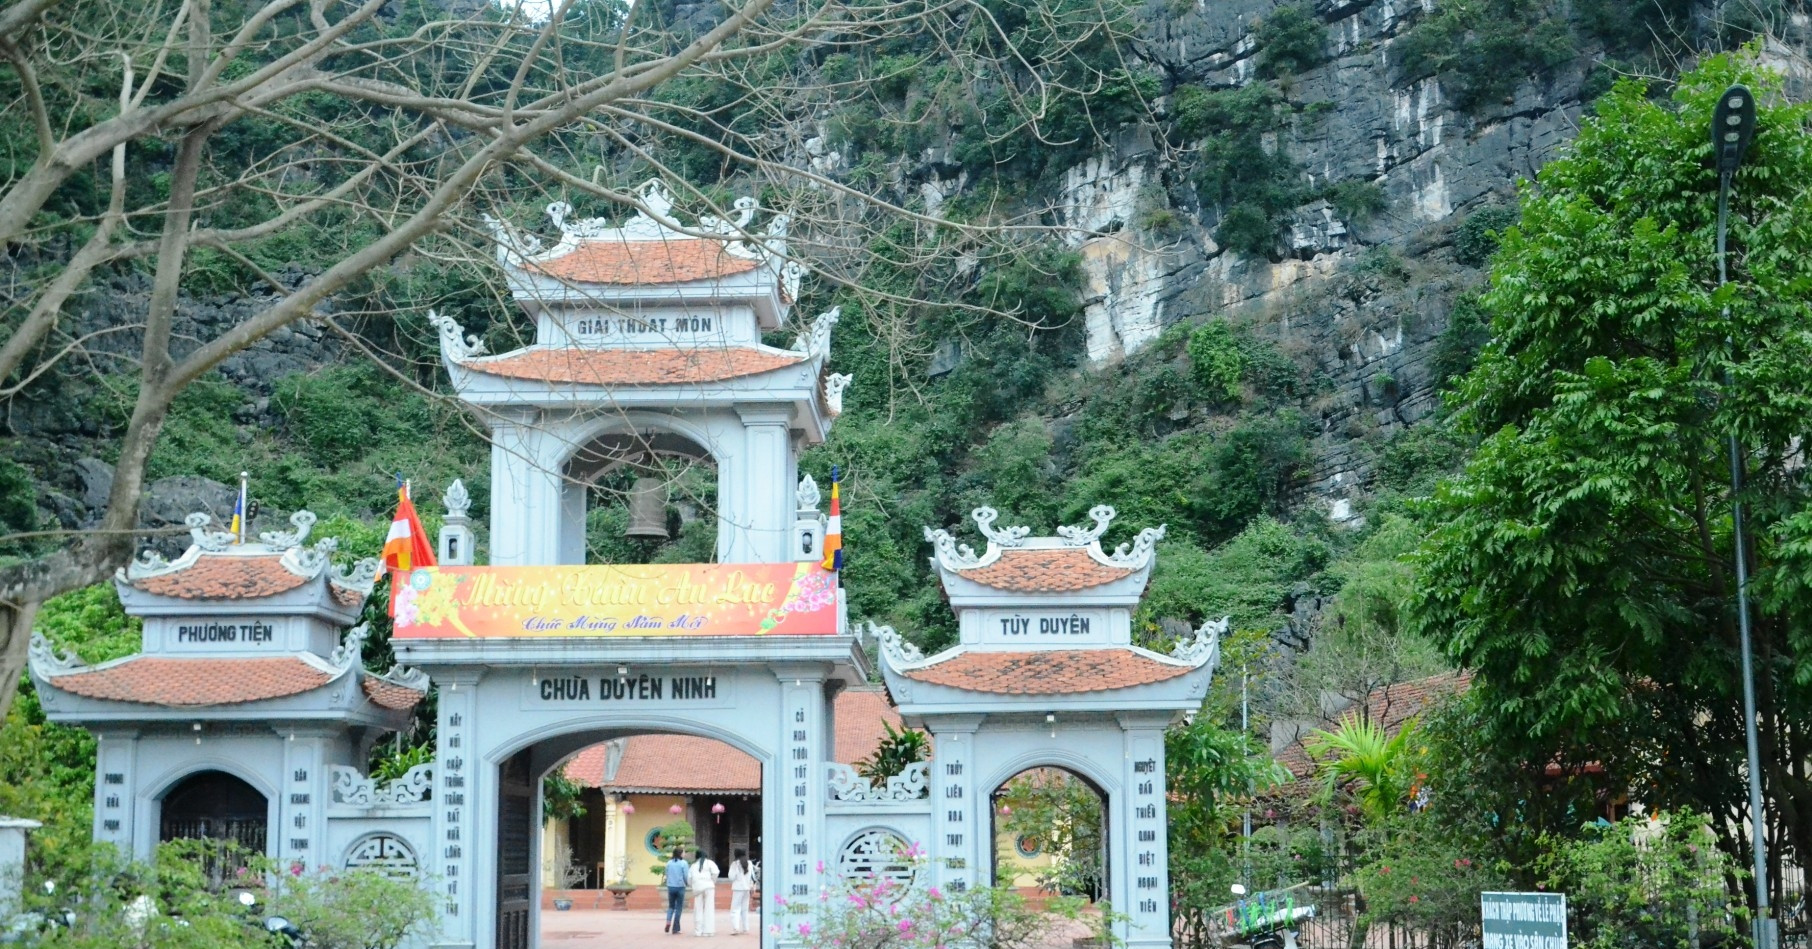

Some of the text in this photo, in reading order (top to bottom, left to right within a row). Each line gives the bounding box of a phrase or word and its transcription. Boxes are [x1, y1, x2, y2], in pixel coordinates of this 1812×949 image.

[675, 315, 711, 332] MÔN
[460, 570, 775, 614] Mừng Xuân An Lạc
[521, 615, 564, 632] Chúc
[1001, 614, 1090, 636] TÙY DUYÊN
[179, 620, 272, 646] PHƯƠNG TIỆN
[541, 674, 716, 700] CHÙA DUYÊN NINH
[793, 730, 806, 741] HOA
[794, 782, 806, 797] GIÓ
[946, 784, 963, 798] LIÊN
[796, 824, 804, 835] BI
[1138, 830, 1155, 842] QUAN
[1139, 850, 1155, 866] BIỆT
[446, 865, 459, 877] SOI
